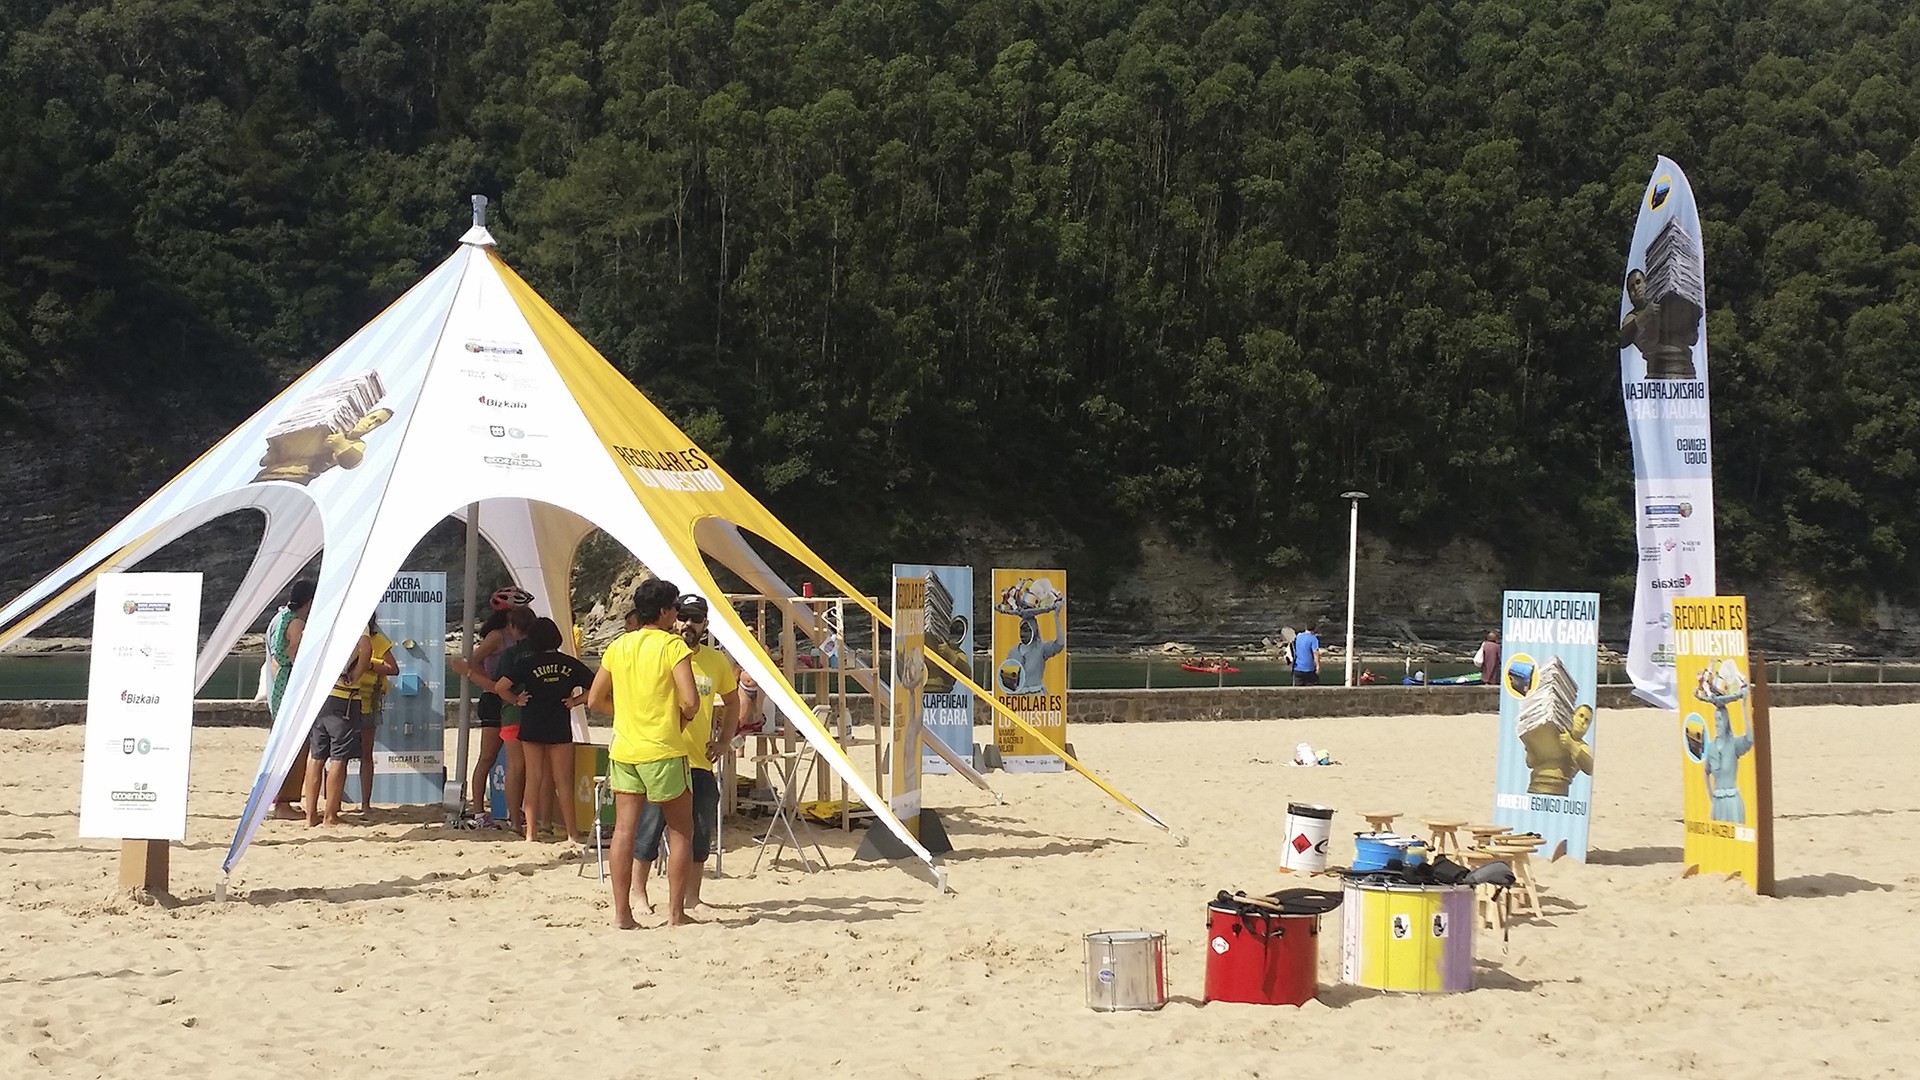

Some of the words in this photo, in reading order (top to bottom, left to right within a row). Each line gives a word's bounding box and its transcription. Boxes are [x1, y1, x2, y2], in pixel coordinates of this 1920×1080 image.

[486, 398, 527, 408] Bizkaia
[613, 445, 688, 471] RECICLAR
[679, 448, 709, 471] ES
[388, 578, 421, 589] UKERA
[1507, 599, 1596, 620] BIRZIKLAPENEAN
[1675, 605, 1726, 630] RECICLAR
[1729, 605, 1743, 630] ES
[1505, 620, 1554, 643] JAIOAK
[1557, 621, 1596, 645] GARA
[1675, 630, 1689, 656] LO
[1692, 630, 1745, 657] NUESTRO
[126, 693, 160, 704] Bizkaia
[999, 696, 1047, 711] RECICLAR
[1050, 695, 1062, 711] ES
[940, 709, 968, 725] GARA
[1012, 711, 1062, 727] UESTRO
[1531, 796, 1560, 813] EGINGO
[1563, 800, 1588, 816] DUGU
